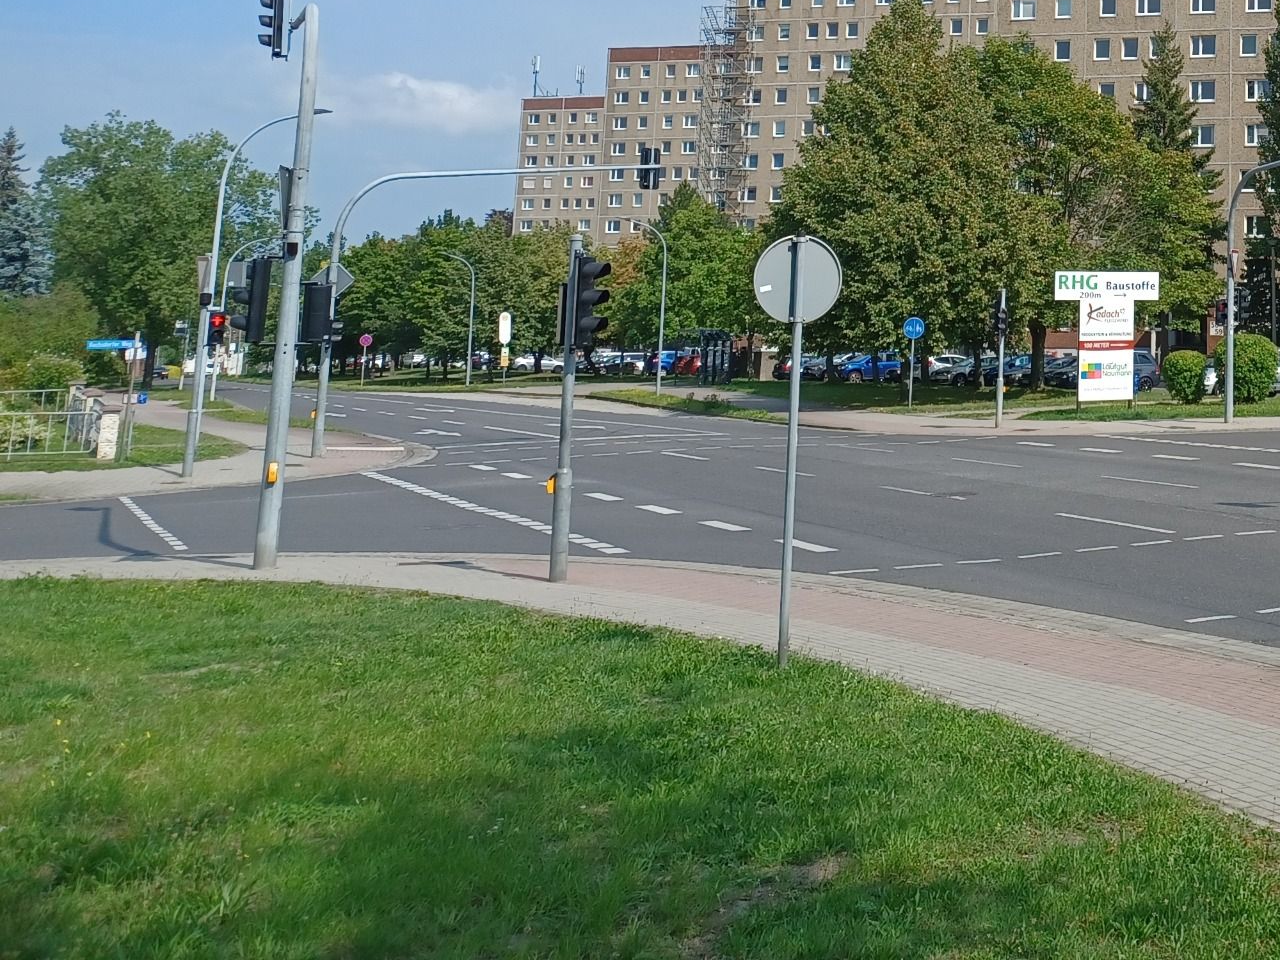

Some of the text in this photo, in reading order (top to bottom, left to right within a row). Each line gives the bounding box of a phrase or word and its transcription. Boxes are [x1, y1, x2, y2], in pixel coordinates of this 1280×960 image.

[1058, 274, 1156, 290] RHG Baustoffe
[1085, 303, 1120, 325] Kadach
